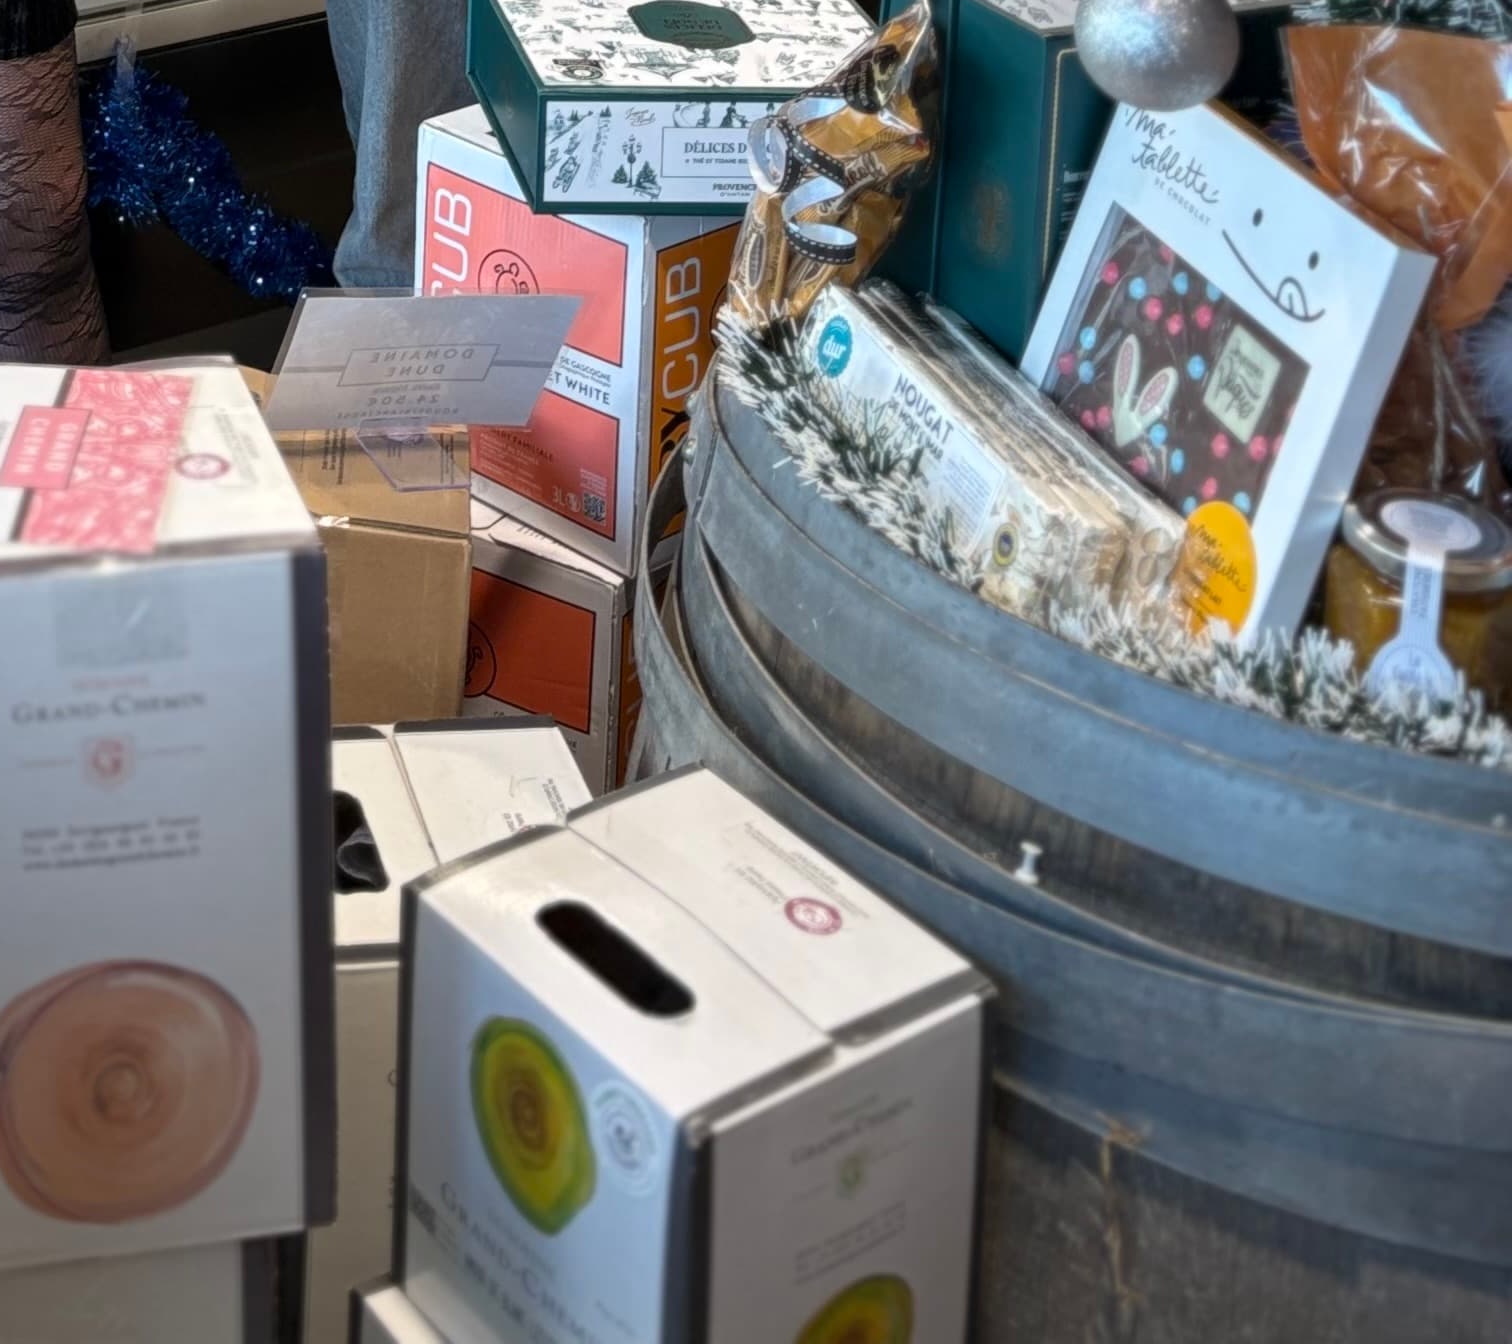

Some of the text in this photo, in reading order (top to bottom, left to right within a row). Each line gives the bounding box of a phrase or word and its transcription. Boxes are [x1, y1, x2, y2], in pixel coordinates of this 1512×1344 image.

[684, 141, 735, 154] DÉLICES
[1131, 145, 1219, 204] tablette
[1168, 186, 1212, 225] CHOCOLAT
[821, 335, 847, 360] dur
[570, 358, 612, 381] GASCOGNE
[565, 375, 611, 406] WHITE
[893, 374, 955, 445] NOUGAT
[13, 417, 50, 475] CHEMIN
[44, 422, 78, 472] GRAND
